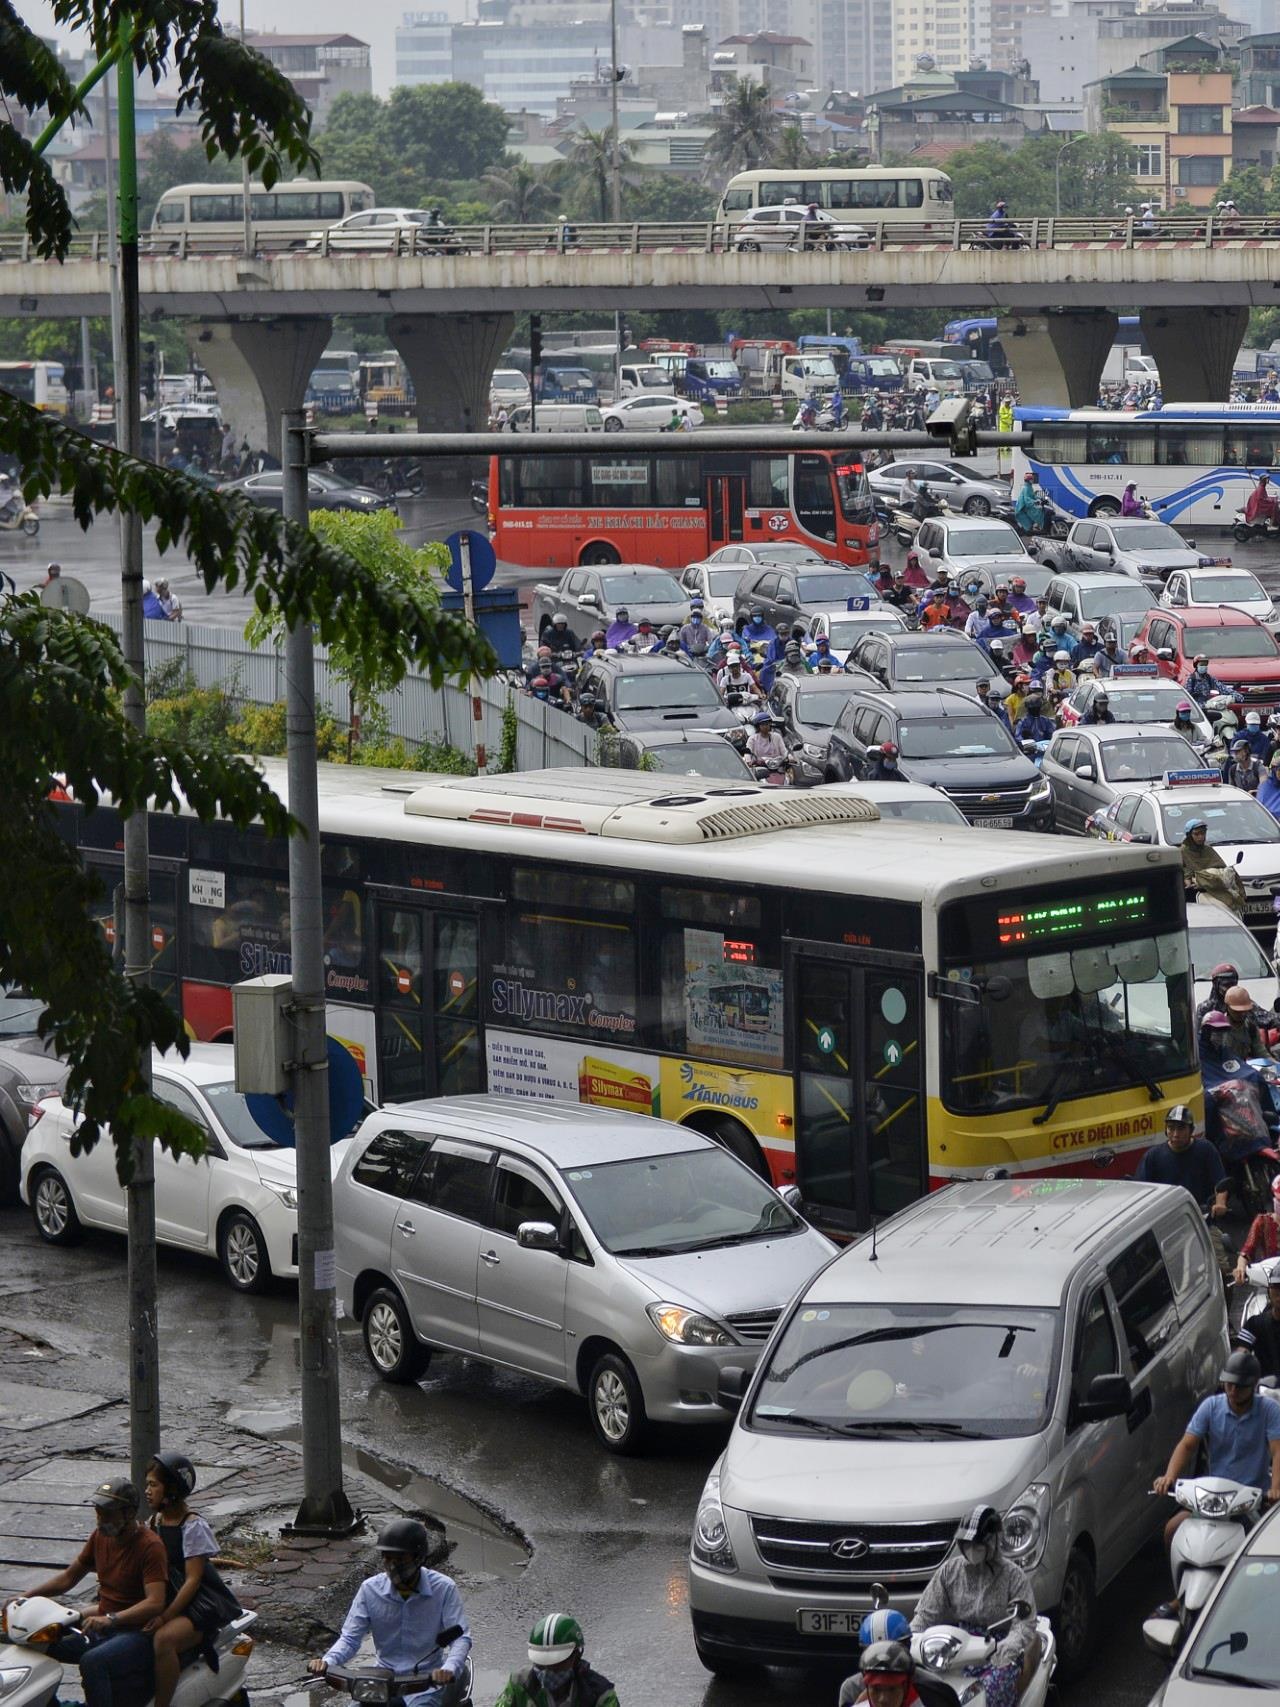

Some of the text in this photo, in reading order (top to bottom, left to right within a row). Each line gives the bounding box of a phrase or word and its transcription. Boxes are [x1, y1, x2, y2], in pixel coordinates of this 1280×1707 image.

[588, 516, 603, 529] XE
[604, 515, 643, 529] KHÁCH
[669, 516, 706, 529] GIANG
[492, 978, 586, 1025] Silymax
[588, 1008, 636, 1033] Complex
[592, 1079, 624, 1097] Silymax
[811, 1613, 868, 1632] 31F-15
